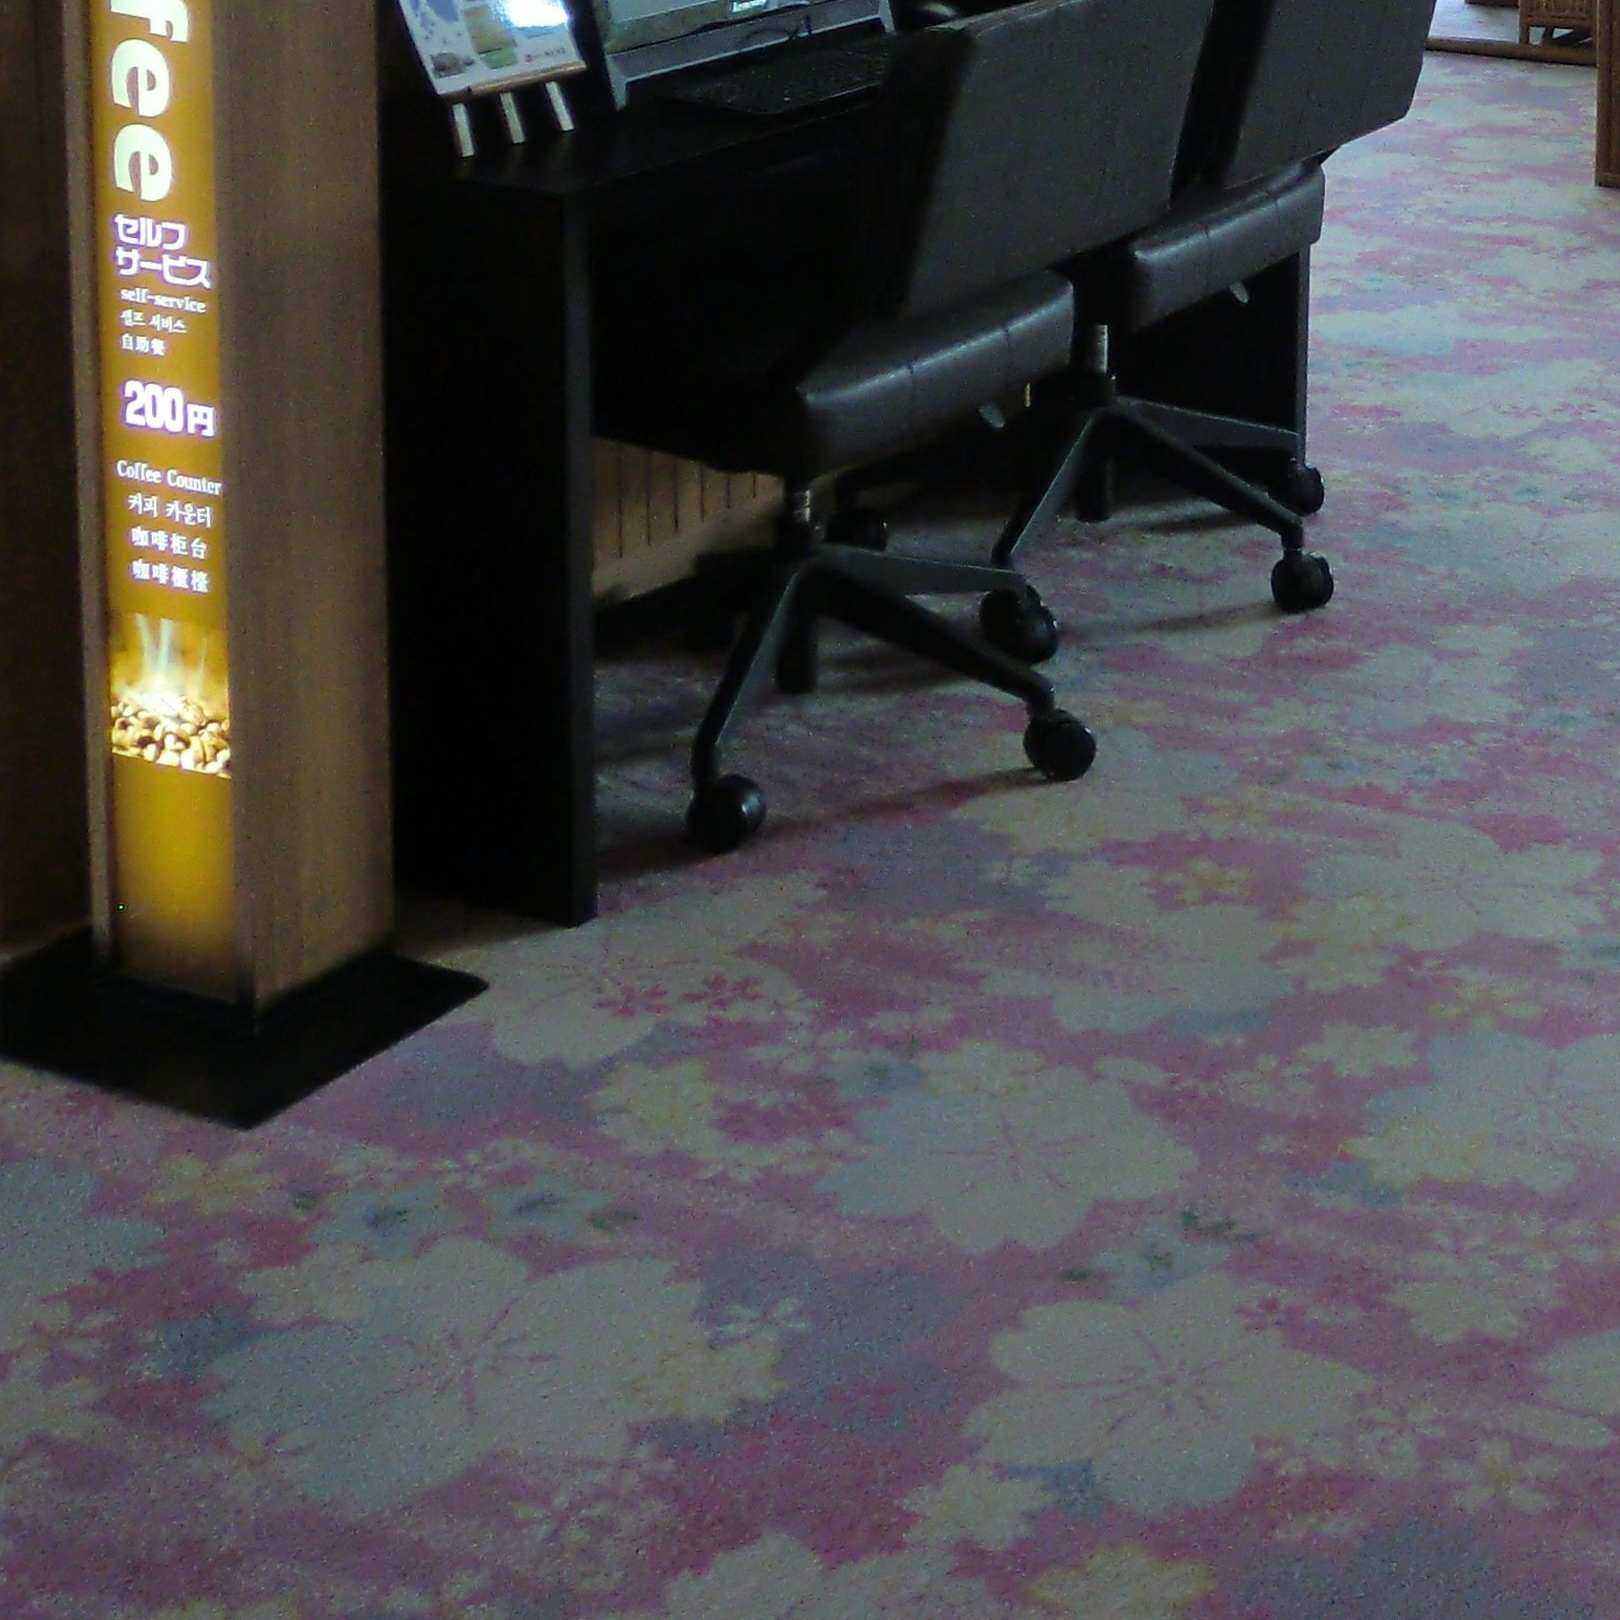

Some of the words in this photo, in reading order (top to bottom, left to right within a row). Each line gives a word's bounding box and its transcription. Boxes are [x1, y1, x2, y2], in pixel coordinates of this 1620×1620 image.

[114, 213, 186, 251] セルフ
[115, 246, 212, 289] サービス
[120, 287, 207, 313] self-service
[149, 313, 188, 334] 서비스
[124, 379, 216, 437] 200円
[117, 460, 162, 484] Coffee
[167, 469, 222, 496] Counter
[127, 492, 158, 518] 커피
[165, 500, 212, 528] 카운터
